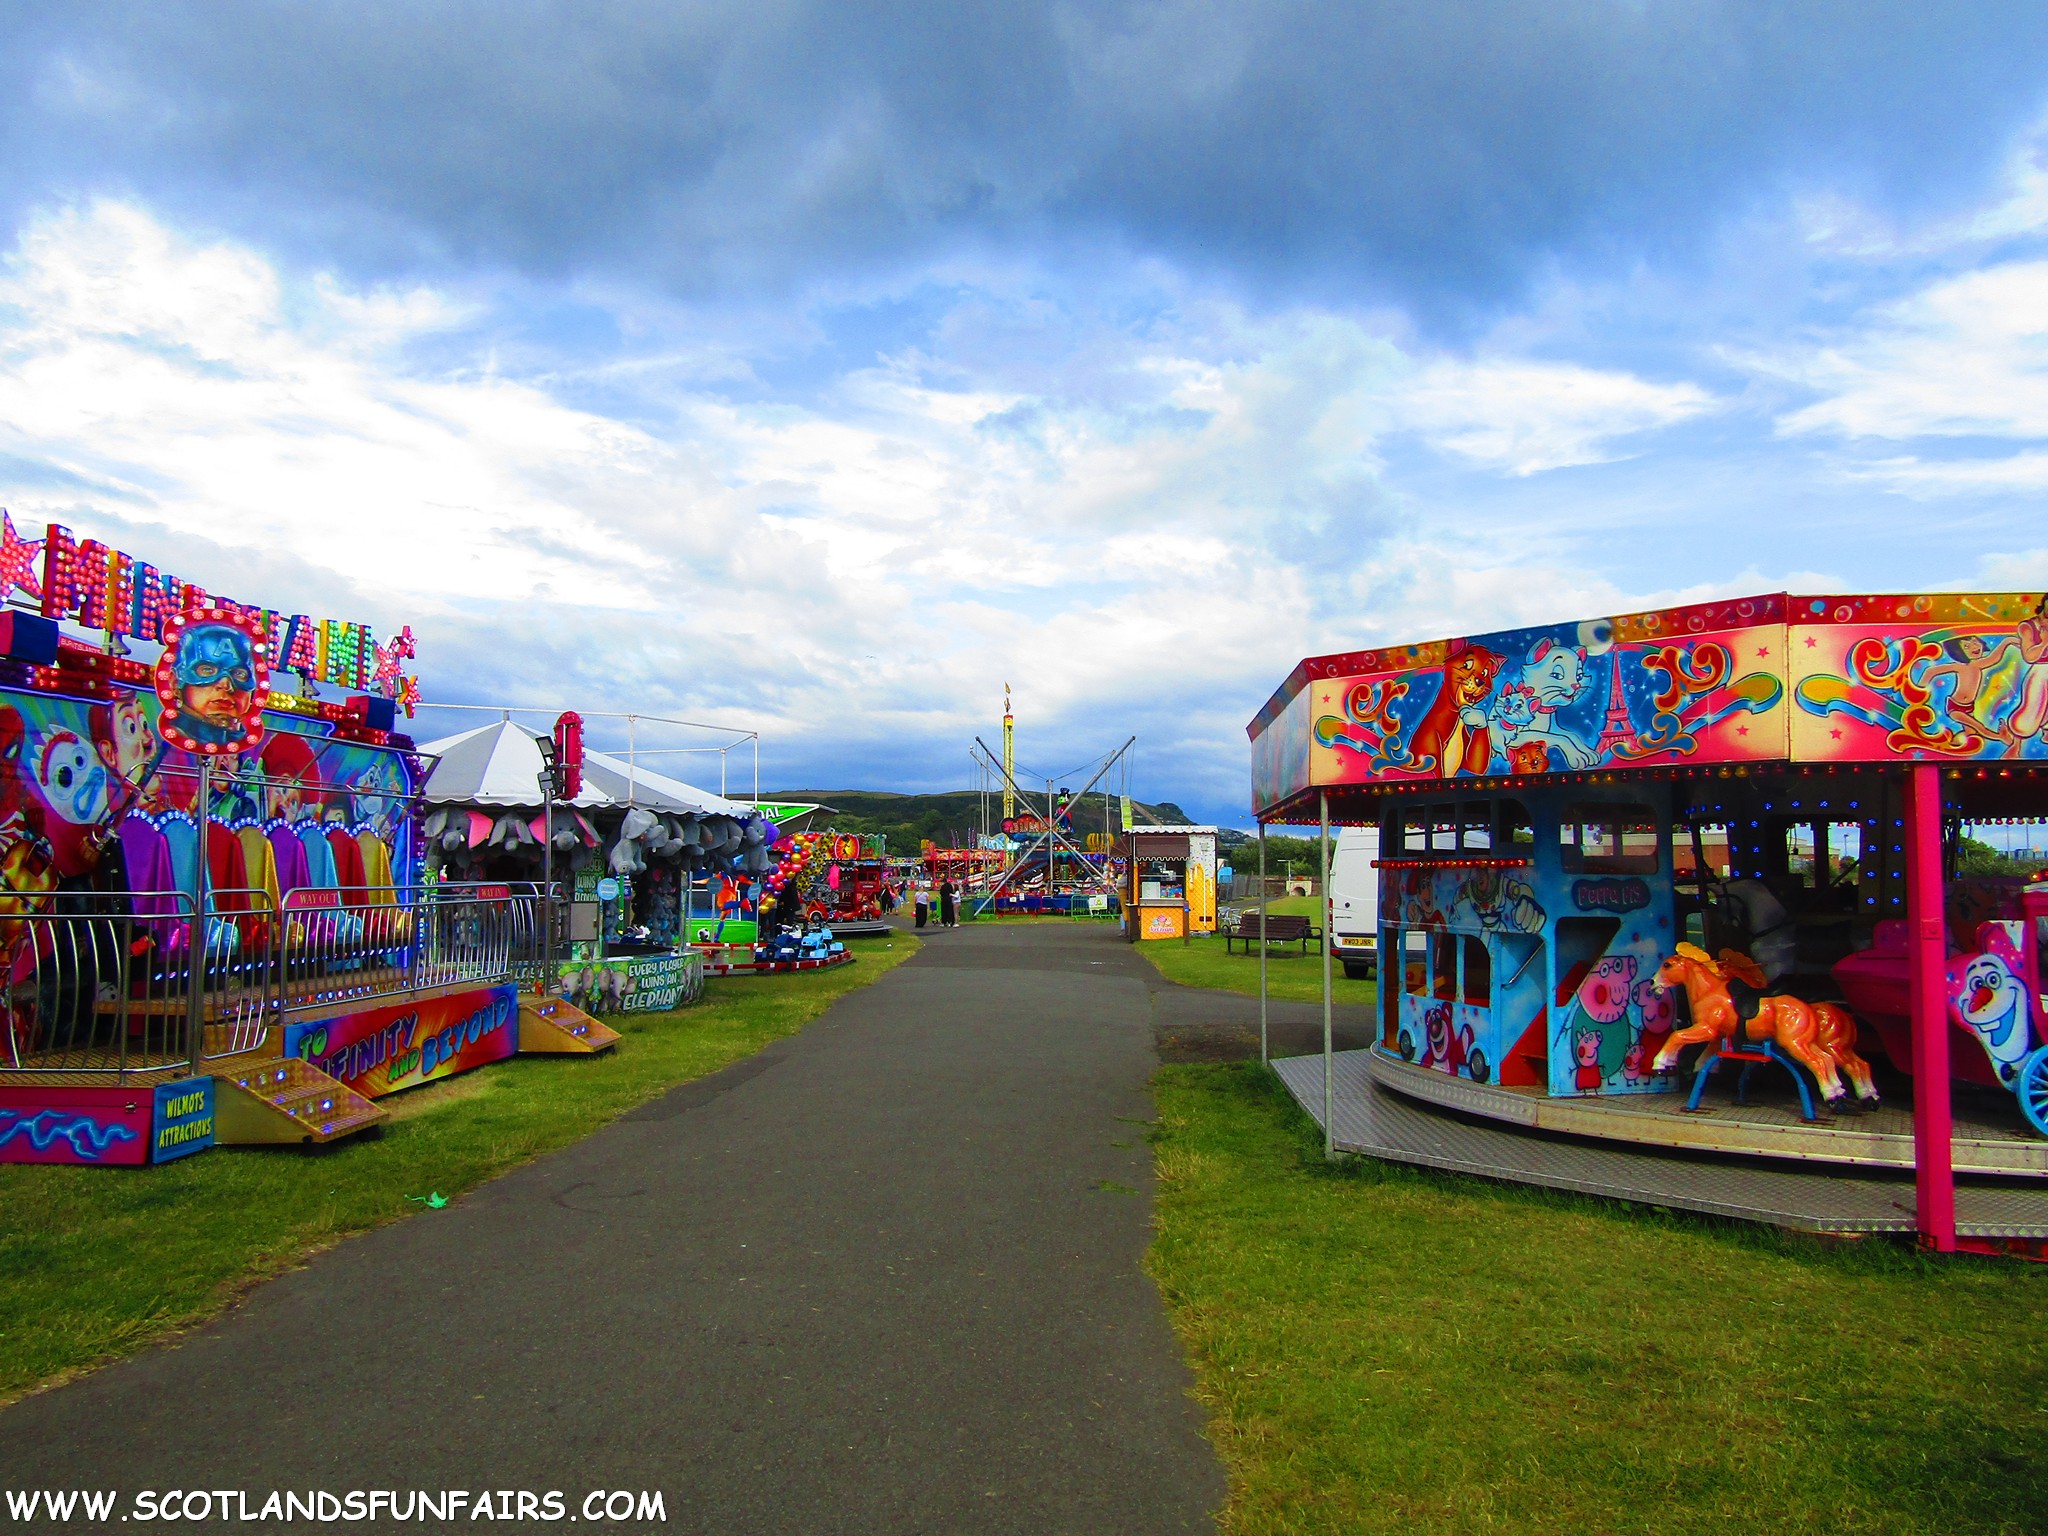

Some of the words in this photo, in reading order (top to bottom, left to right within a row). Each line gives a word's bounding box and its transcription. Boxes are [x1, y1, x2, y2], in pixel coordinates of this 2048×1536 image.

[300, 893, 317, 905] WAY
[319, 892, 337, 904] OUT
[481, 888, 494, 898] WAY
[495, 887, 502, 897] IN
[628, 962, 657, 977] EVERY
[659, 957, 685, 973] PLAYER
[641, 974, 665, 989] WINS
[667, 972, 677, 985] AN
[622, 984, 684, 1011] ELEPHANT
[299, 1027, 328, 1062] TO
[314, 1010, 419, 1082] FINITY
[421, 994, 510, 1076] BEYOND
[386, 1046, 421, 1084] AND
[166, 1090, 205, 1119] WILMOTS
[158, 1116, 212, 1149] ATTRACTIONS
